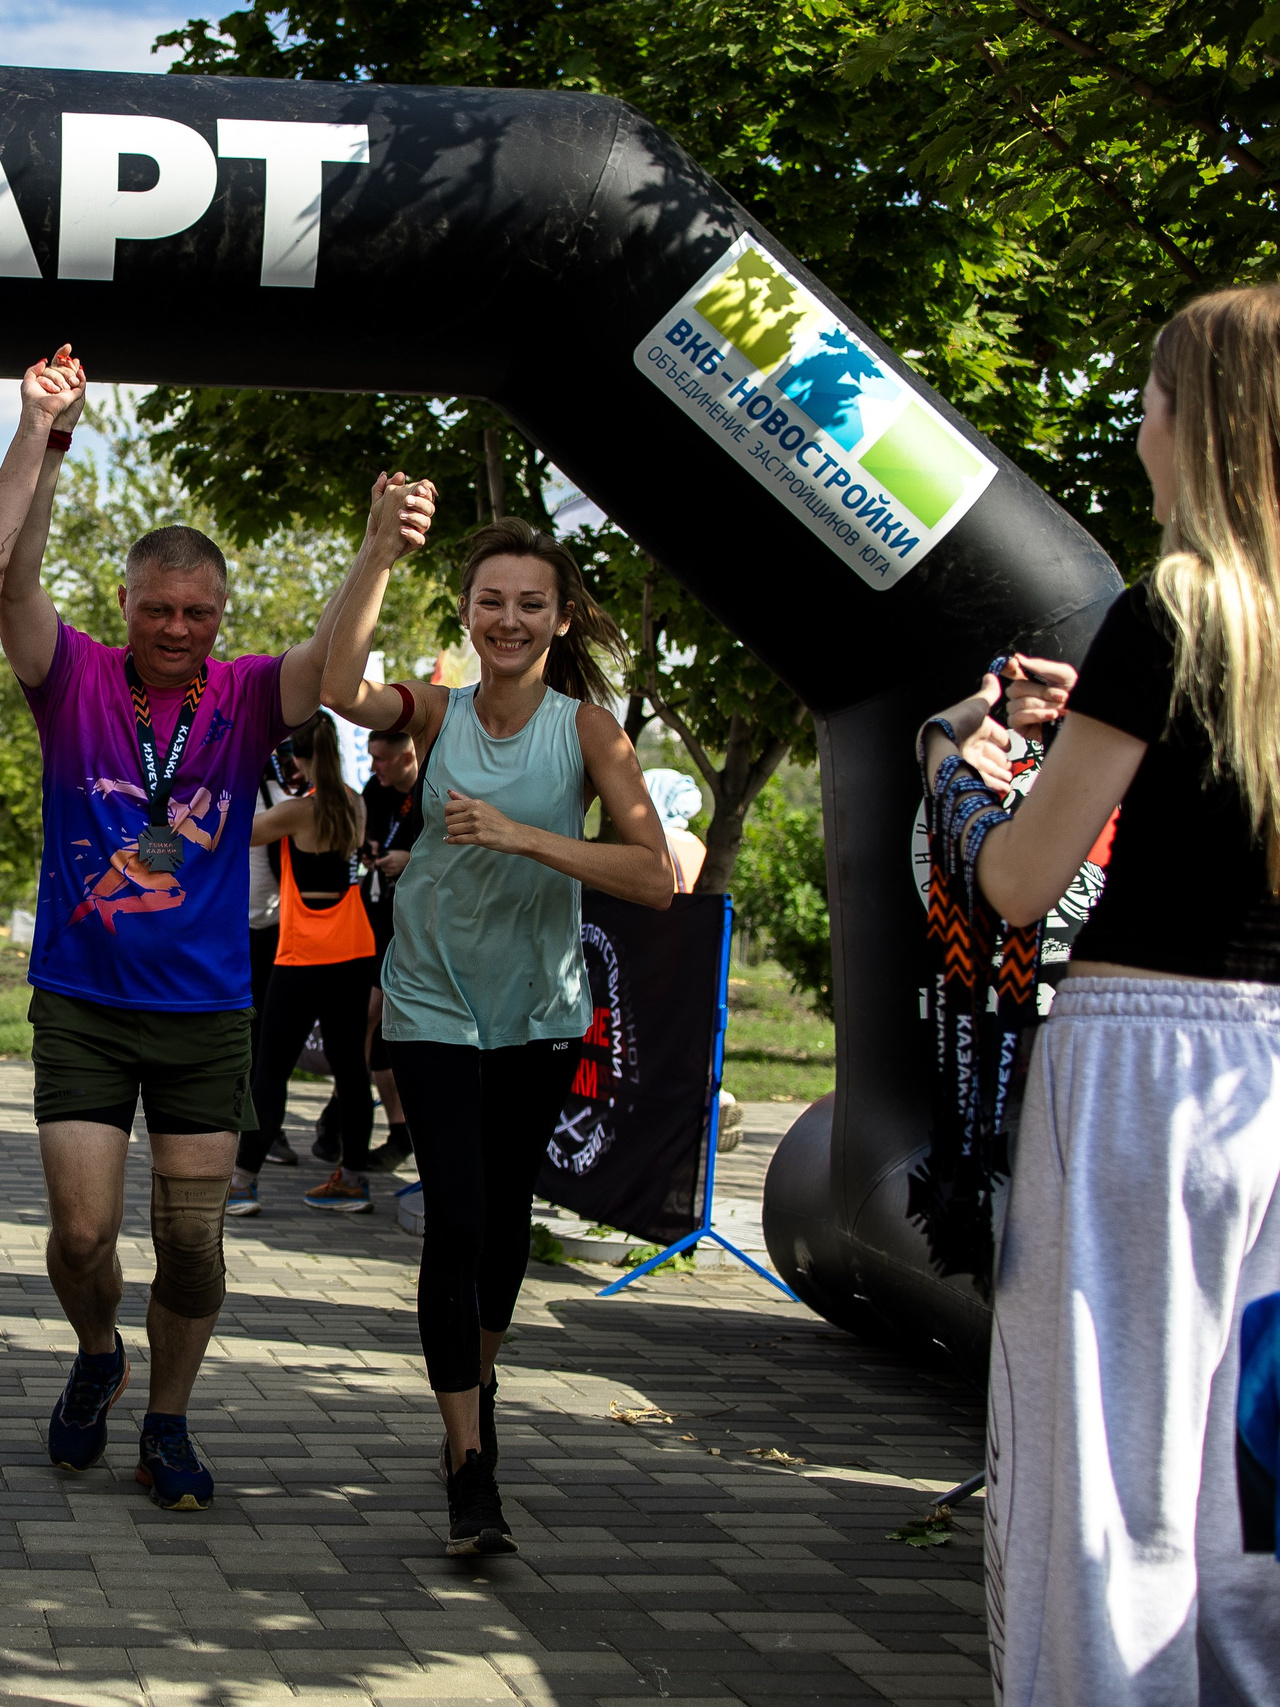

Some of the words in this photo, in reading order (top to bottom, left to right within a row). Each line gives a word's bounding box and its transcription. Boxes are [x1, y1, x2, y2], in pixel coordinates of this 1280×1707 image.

[647, 346, 750, 444] ОБЪЕДИНЕНИЕ
[747, 440, 860, 547] ЗАСТРОЙЩИКОВ
[857, 543, 891, 578] ЮГА
[142, 742, 159, 797] АЗАКИ
[163, 724, 189, 779] КАЗАКИ
[581, 923, 622, 1079] ЕПЯТСТВИЯМИ
